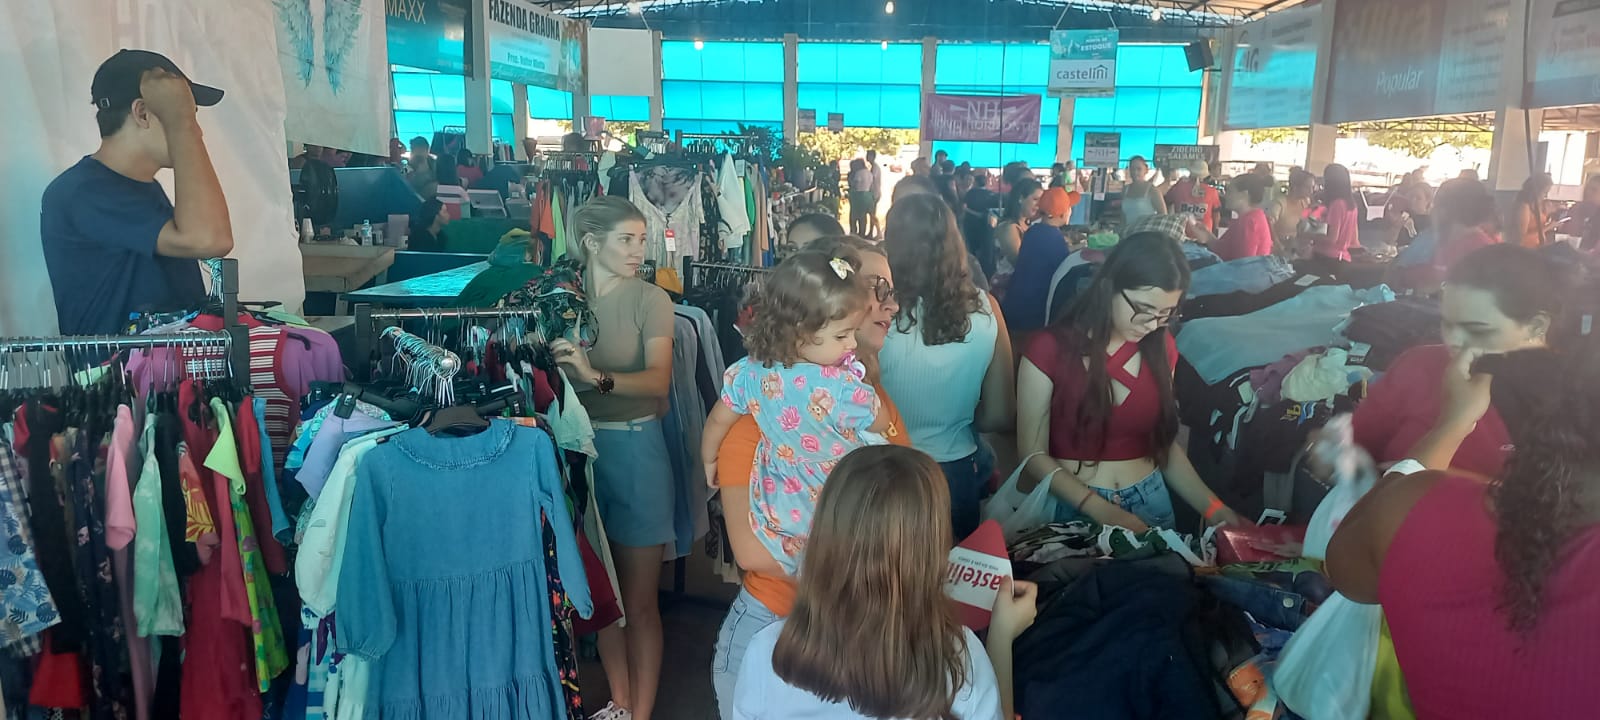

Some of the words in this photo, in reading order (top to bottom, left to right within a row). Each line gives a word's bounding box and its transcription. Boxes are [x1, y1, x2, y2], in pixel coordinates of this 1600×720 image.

[489, 0, 528, 31] FAZENDA
[529, 11, 560, 41] GRAÚNA
[1056, 65, 1108, 80] castelini
[1375, 65, 1424, 98] Popular
[967, 101, 1001, 120] NH
